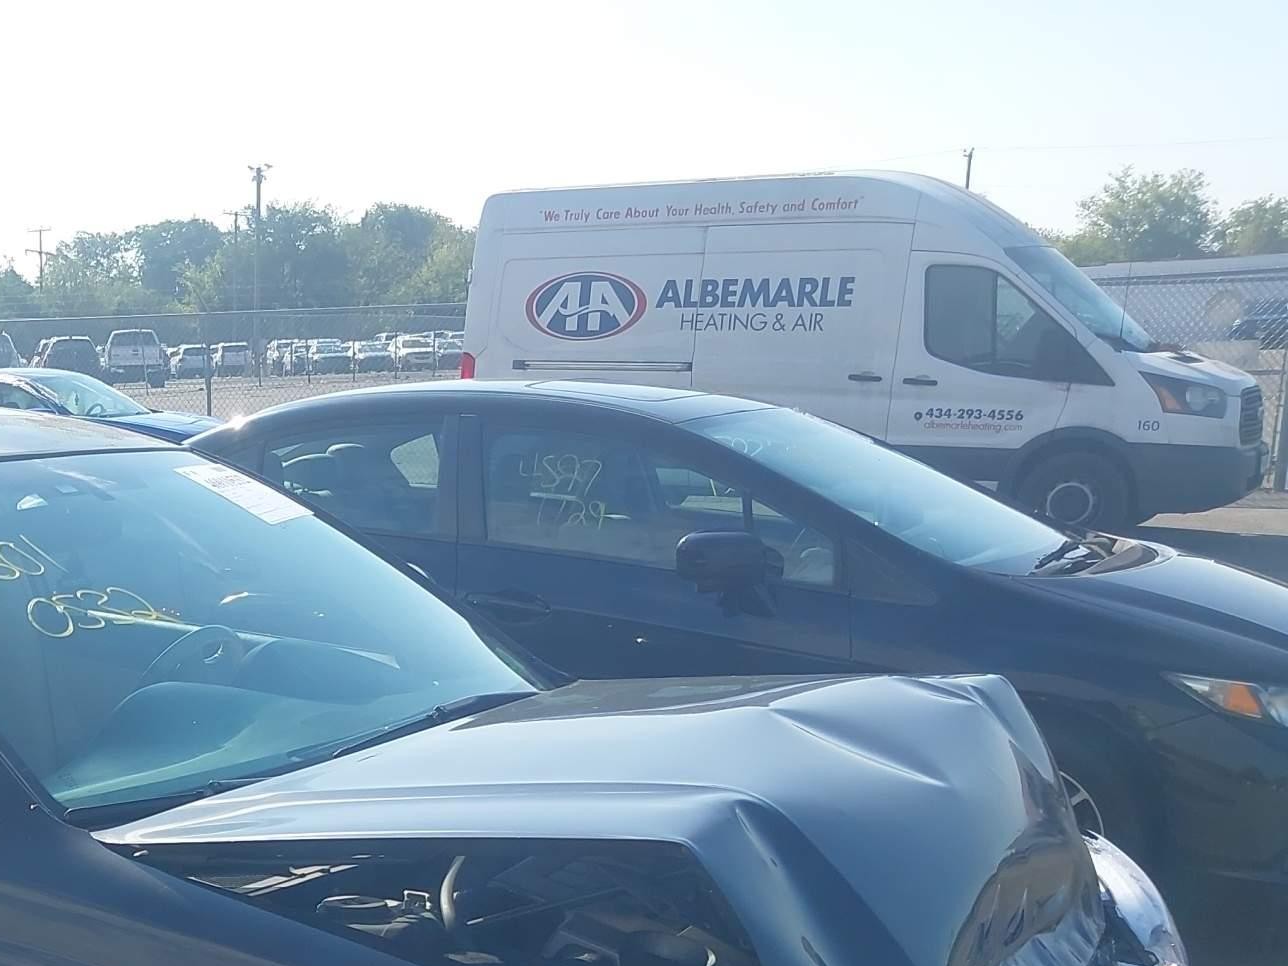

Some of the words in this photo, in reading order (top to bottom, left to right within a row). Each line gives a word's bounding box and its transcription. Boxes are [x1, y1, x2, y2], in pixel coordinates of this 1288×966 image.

[564, 207, 591, 222] Truly
[596, 208, 621, 220] Care
[624, 207, 660, 219] About
[666, 205, 690, 217] Your
[739, 200, 778, 215] Safety
[782, 199, 805, 212] and
[656, 276, 856, 309] ALBEMARLE
[679, 313, 768, 332] HEATING
[771, 314, 787, 331] &
[791, 313, 824, 331] AIR
[925, 407, 1024, 421] 434-293-4556
[1138, 420, 1160, 431] 160
[519, 452, 602, 496] 4597
[27, 586, 187, 637] 0532
